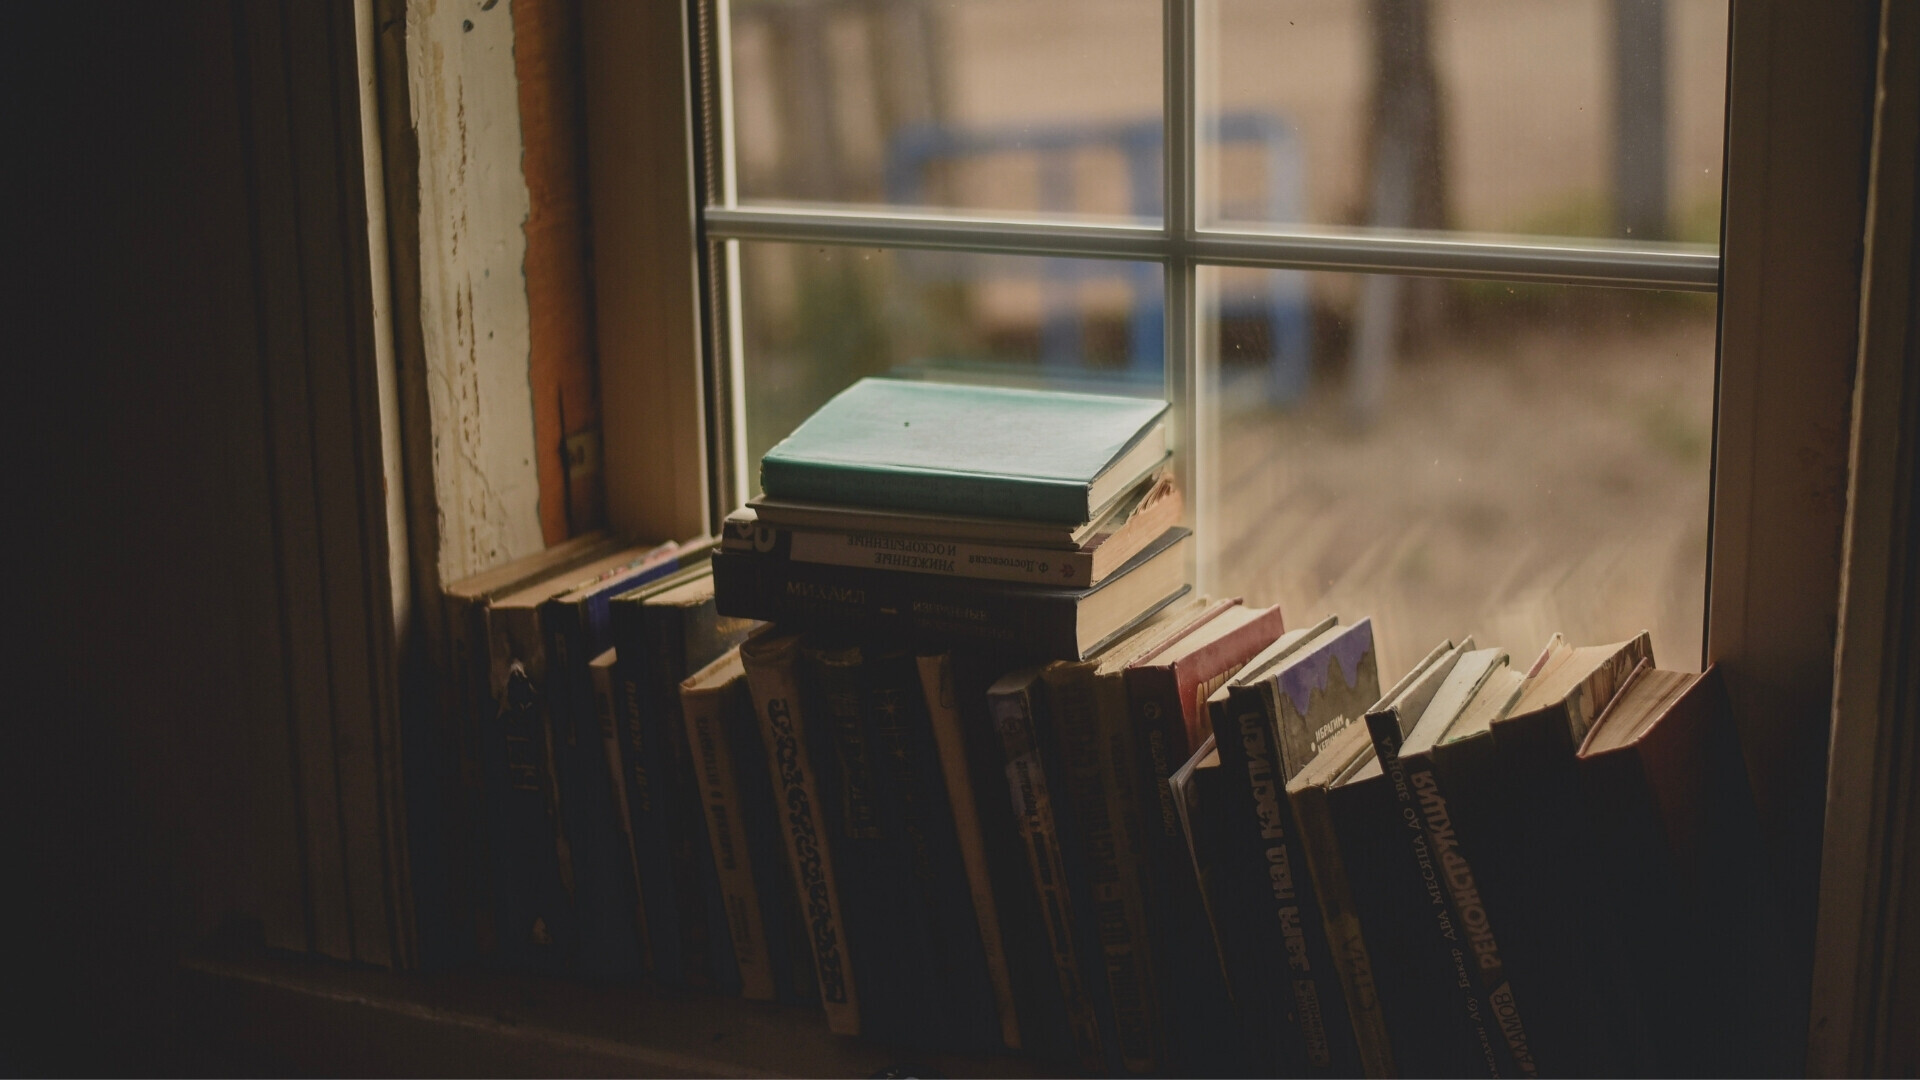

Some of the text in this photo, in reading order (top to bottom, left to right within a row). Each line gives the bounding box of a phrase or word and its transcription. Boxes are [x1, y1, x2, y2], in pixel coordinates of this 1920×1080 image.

[847, 535, 945, 554] ОСКОРБЛЕННЫЕ
[874, 552, 955, 573] УНИЖЕННЫЕ
[969, 555, 1035, 573] Достоевский
[786, 582, 866, 605] МИХАИЛ
[1383, 736, 1409, 801] ЗВОНКА
[1402, 806, 1422, 831] ДО
[1410, 769, 1501, 971] РЕКОНСТРУКЦИЯ
[1413, 833, 1444, 907] МЕСЯЦА
[1434, 910, 1459, 942] ДВА
